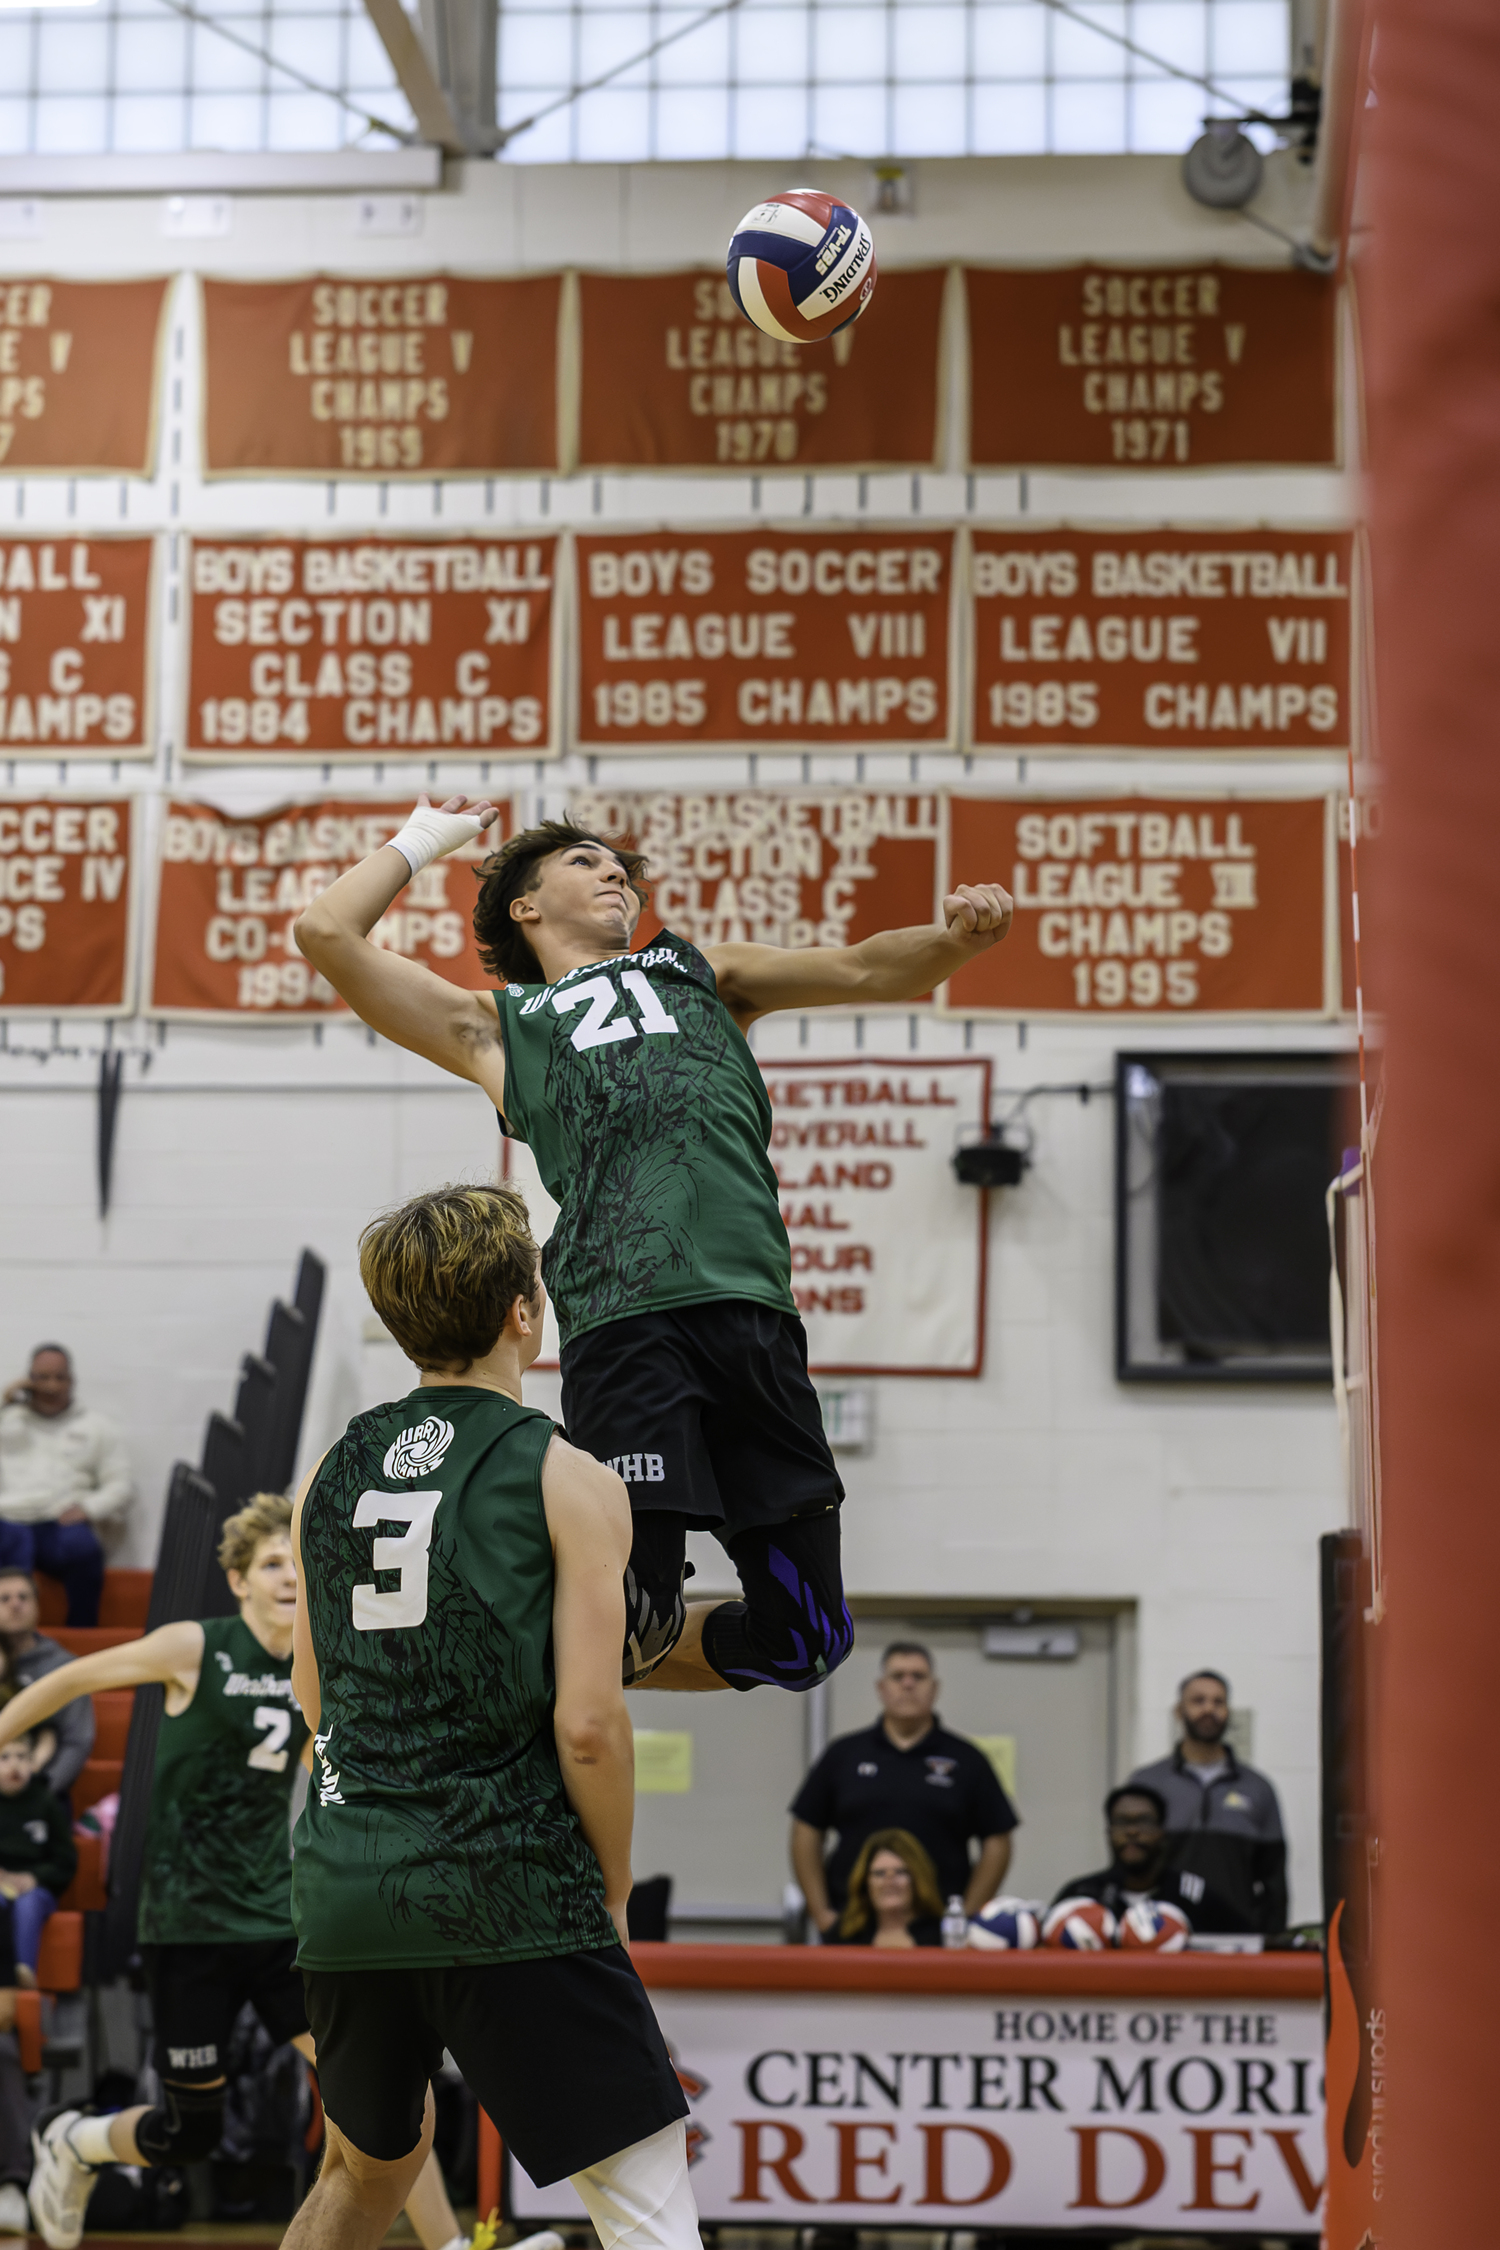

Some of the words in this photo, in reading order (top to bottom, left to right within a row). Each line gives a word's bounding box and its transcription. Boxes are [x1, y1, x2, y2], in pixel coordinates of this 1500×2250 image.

[313, 284, 448, 329] SOCCER
[1084, 276, 1219, 317] SOCCER
[289, 332, 425, 375] LEAGUE
[666, 328, 801, 370] LEAGUE
[1059, 323, 1196, 366] LEAGUE
[311, 376, 449, 421] CHAMPS
[689, 371, 828, 415] CHAMPS
[1084, 370, 1223, 414] CHAMPS
[339, 425, 423, 467] 1969
[1111, 419, 1188, 461] 1971
[194, 547, 295, 593] BOYS
[303, 545, 551, 594] BASKETBALL
[588, 550, 713, 598] BOYS
[746, 550, 941, 596] SOCCER
[973, 551, 1078, 597] BOYS
[1091, 551, 1348, 598] BASKETBALL
[80, 595, 127, 641] XI
[214, 599, 432, 645] SECTION
[484, 598, 529, 644] XI
[603, 613, 796, 660] LEAGUE
[847, 613, 926, 658] VIII
[1000, 616, 1200, 662] LEAGUE
[1267, 617, 1326, 663] VII
[50, 647, 83, 694] C
[251, 651, 413, 698] CLASS
[456, 651, 490, 697] C
[199, 699, 310, 744] 1984
[343, 699, 543, 743] CHAMPS
[593, 679, 706, 728] 1985
[737, 679, 937, 726] CHAMPS
[989, 682, 1098, 728] 1985
[1144, 683, 1338, 729] CHAMPS
[162, 816, 261, 864] BOYS
[681, 796, 937, 842] BASKETBALL
[1016, 814, 1256, 859] SOFTBALL
[81, 856, 126, 901] IV
[638, 838, 822, 880] SECTION
[654, 879, 803, 922] CLASS
[822, 879, 857, 921] C
[1013, 863, 1184, 909] LEAGUE
[1038, 911, 1233, 957] CHAMPS
[1073, 960, 1200, 1006] 1995
[552, 969, 680, 1053] 21
[351, 1489, 444, 1631] 3
[247, 1705, 292, 1774] 2
[994, 2010, 1117, 2043] HOME
[1128, 2012, 1184, 2044] OF
[1193, 2013, 1277, 2045] THE
[745, 2050, 1066, 2110] CENTER
[1089, 2055, 1325, 2116] MORI
[729, 2119, 1015, 2207] RED
